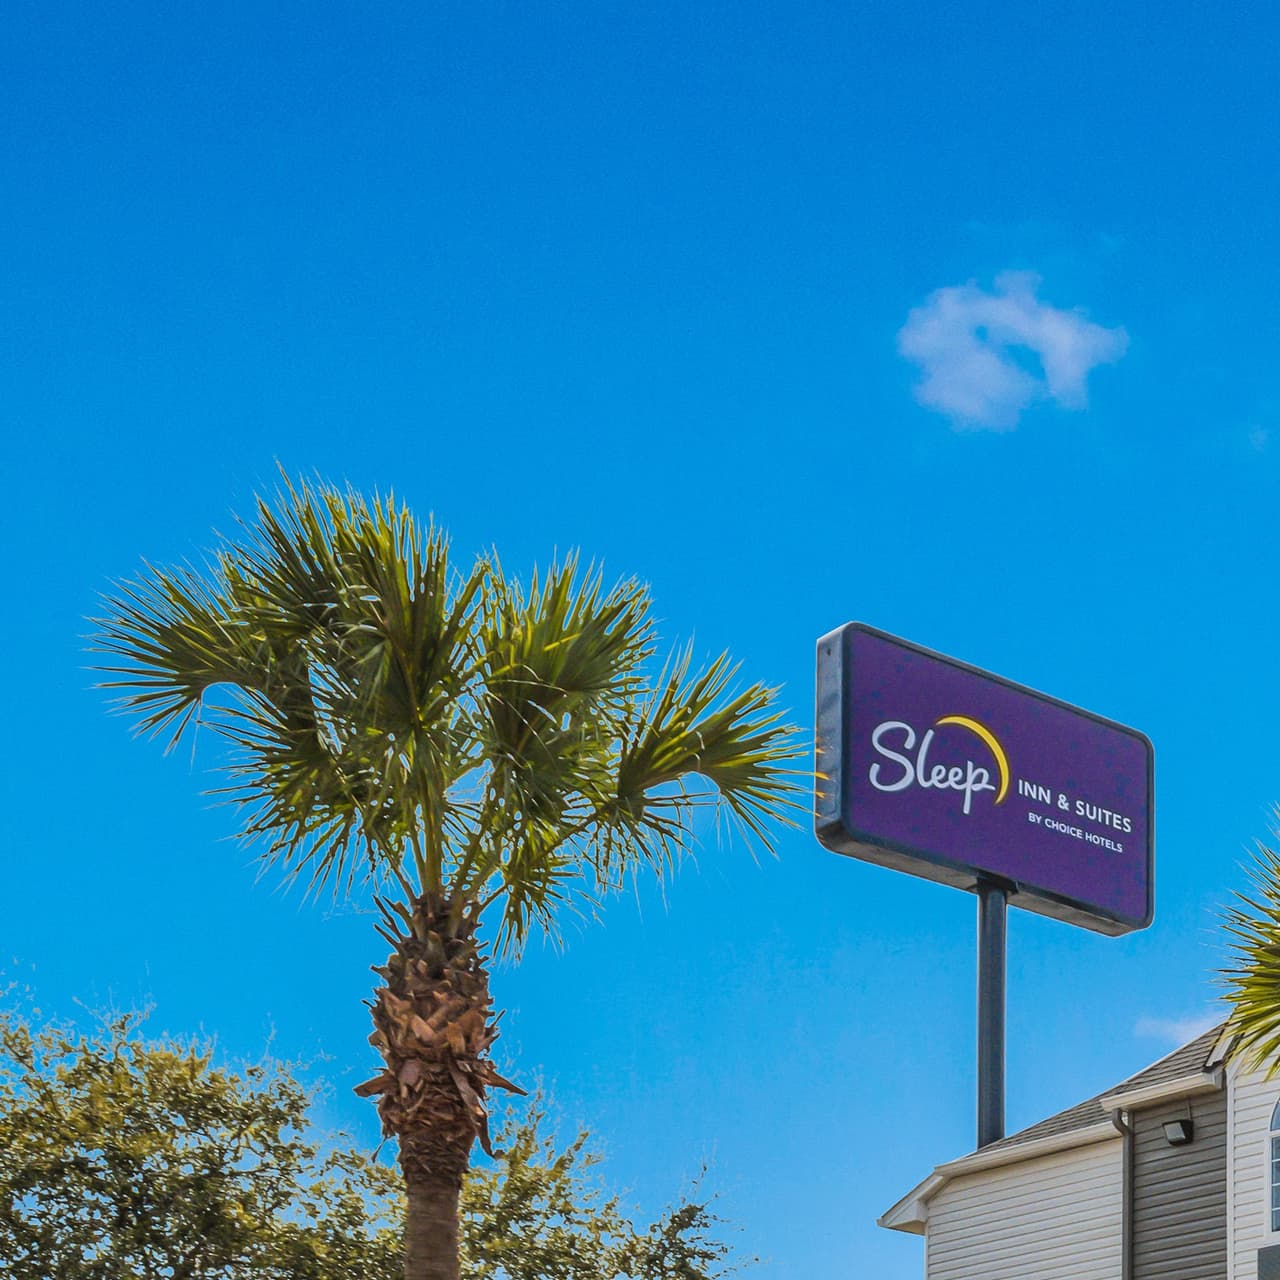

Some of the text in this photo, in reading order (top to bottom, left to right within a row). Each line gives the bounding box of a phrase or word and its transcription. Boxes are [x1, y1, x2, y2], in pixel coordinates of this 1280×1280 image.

[869, 720, 996, 814] Sleep
[1018, 779, 1132, 833] INN & SUITES
[1028, 812, 1123, 853] BY CHOICE HOTELS
